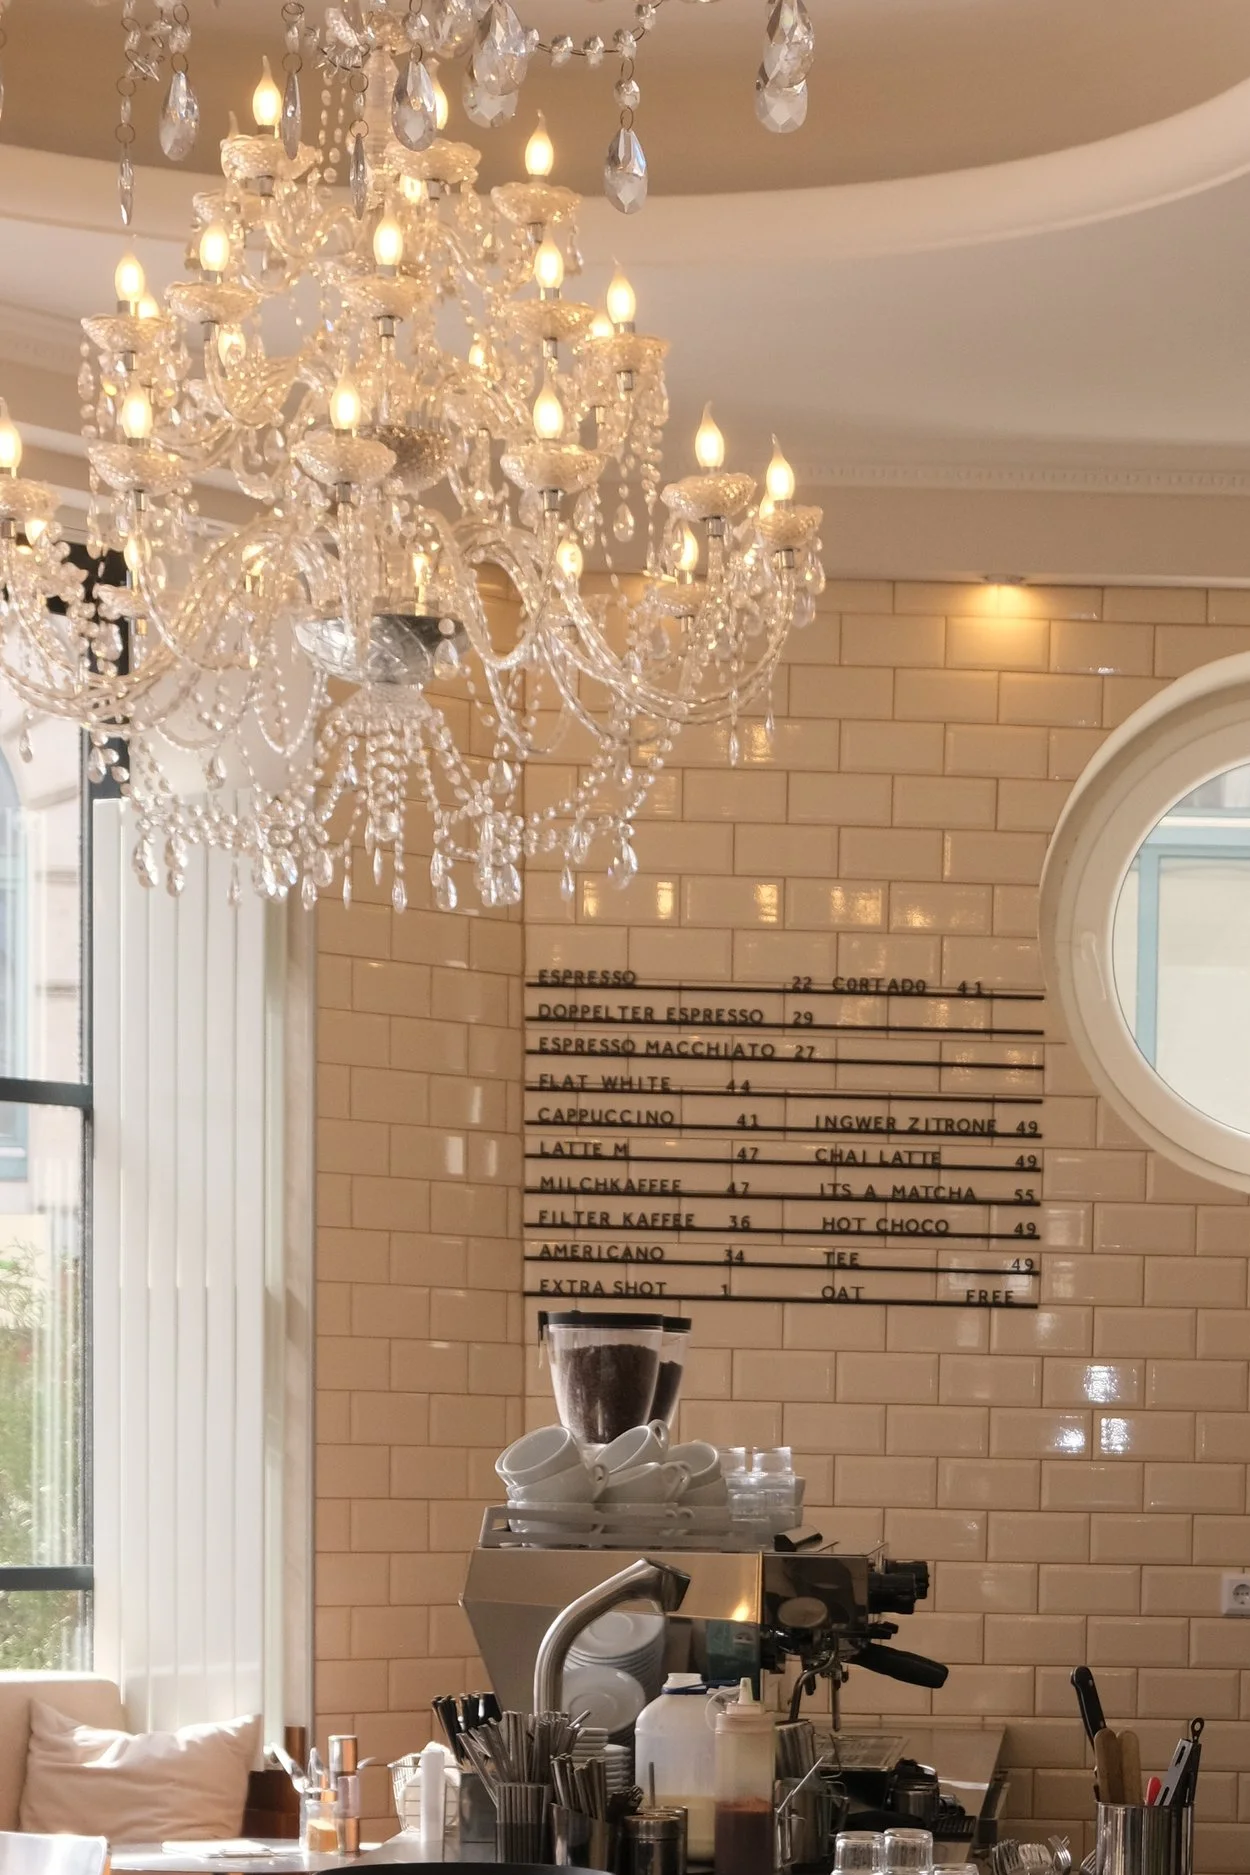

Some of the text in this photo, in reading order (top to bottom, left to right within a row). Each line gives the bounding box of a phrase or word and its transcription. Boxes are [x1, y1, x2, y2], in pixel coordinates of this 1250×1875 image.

[538, 969, 812, 990] ESPRESSO 22
[538, 1003, 814, 1025] DOPPELTER ESPRESSO 29
[538, 1036, 815, 1059] ESPRESSO MACCHIATO 27
[538, 1074, 750, 1093] FLAT WHITE 44
[538, 1107, 759, 1127] CAPPUCCINO 41
[815, 1114, 1038, 1135] INGWER ZITRONE 49
[540, 1140, 759, 1161] LATTE M 47
[815, 1148, 1037, 1168] CHAI LATTE 49
[540, 1176, 749, 1194] MILCHKAFFEE 47
[820, 1183, 1035, 1202] ITS A MATCHA 55
[538, 1209, 750, 1229] FILTER KAFFEE 36
[822, 1217, 1036, 1236] HOT CHOCO 49
[539, 1244, 745, 1263] AMERICANO 34
[824, 1251, 1034, 1272] TEE 49
[539, 1279, 604, 1295] EXTRA
[612, 1281, 667, 1296] SHOT
[821, 1286, 1015, 1305] OAT FREE
